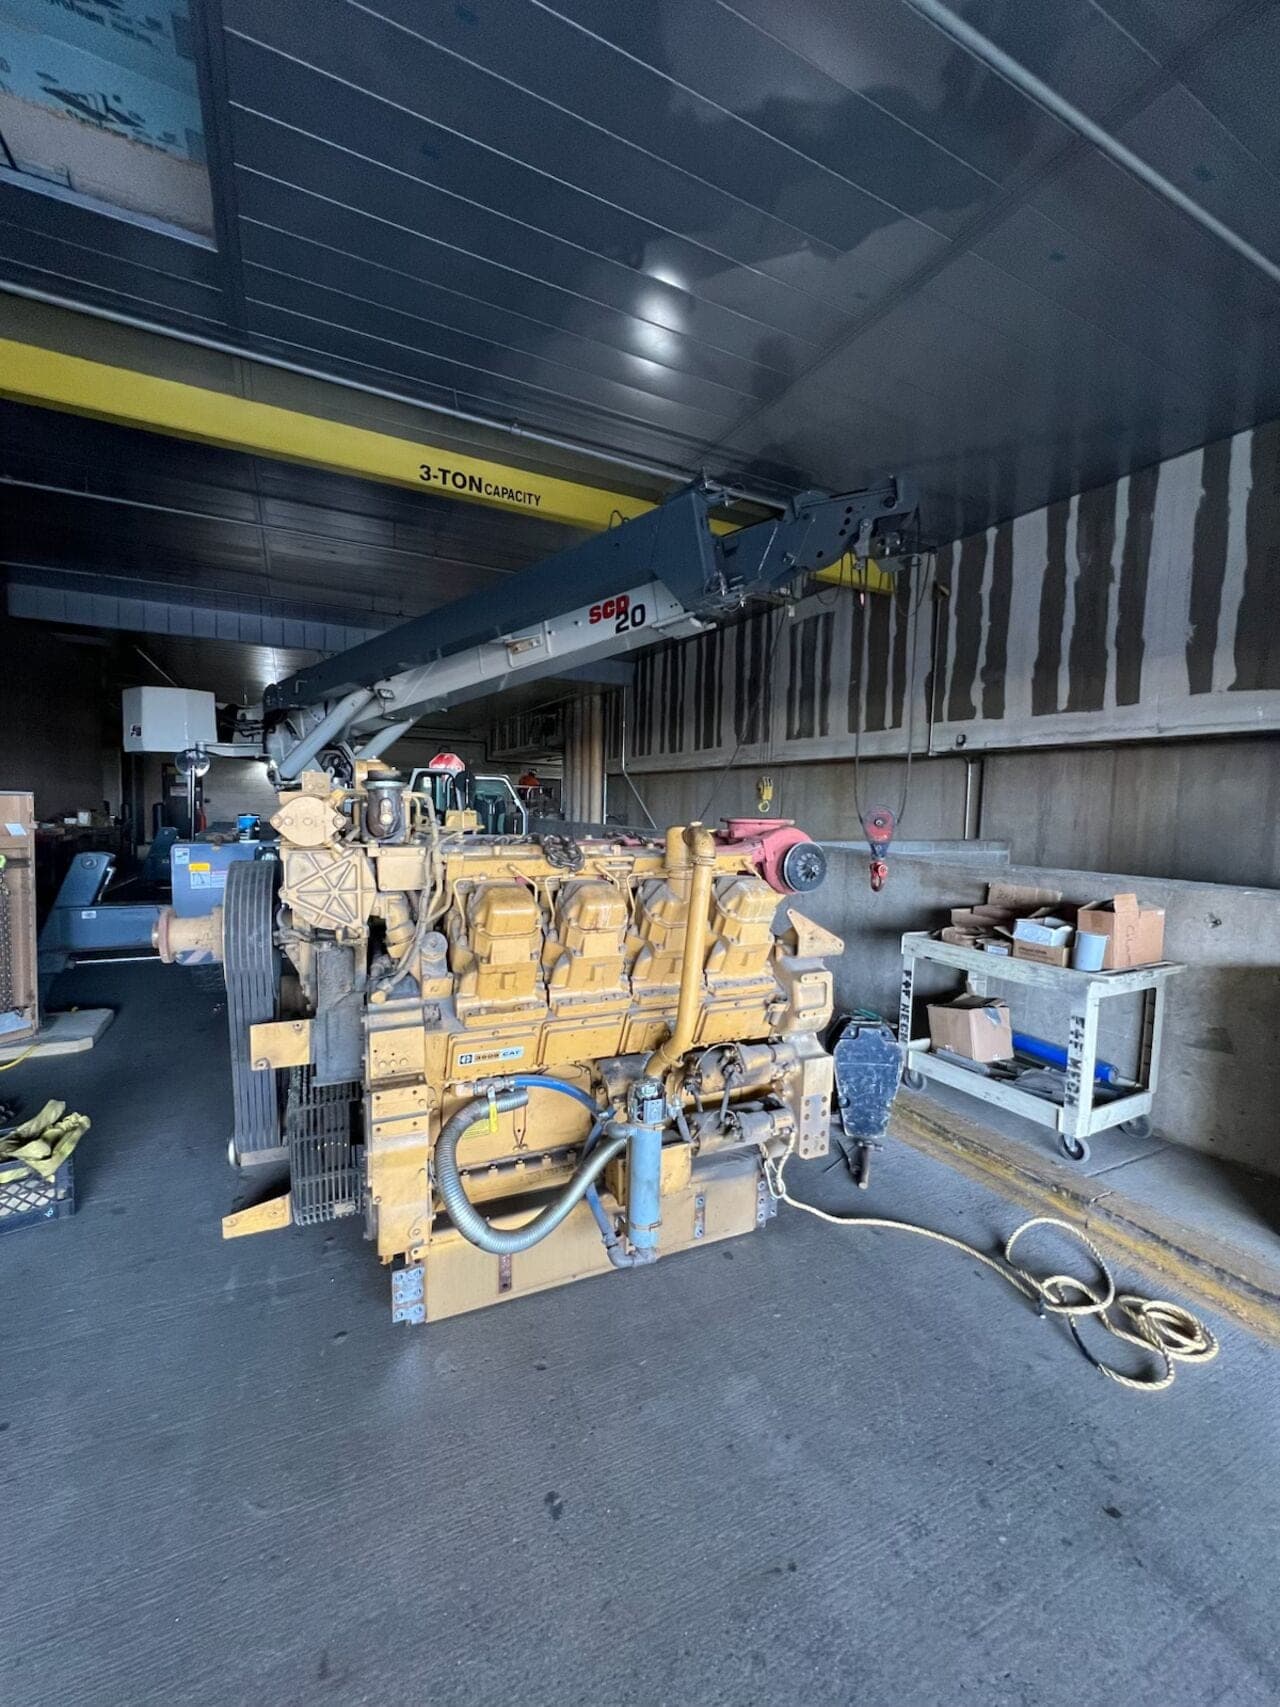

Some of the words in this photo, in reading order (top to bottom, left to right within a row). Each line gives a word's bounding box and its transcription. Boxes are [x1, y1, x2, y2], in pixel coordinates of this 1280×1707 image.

[419, 464, 482, 493] 3-TON
[484, 483, 541, 507] CAPACITY
[615, 603, 646, 634] 20
[502, 1048, 521, 1058] CAT
